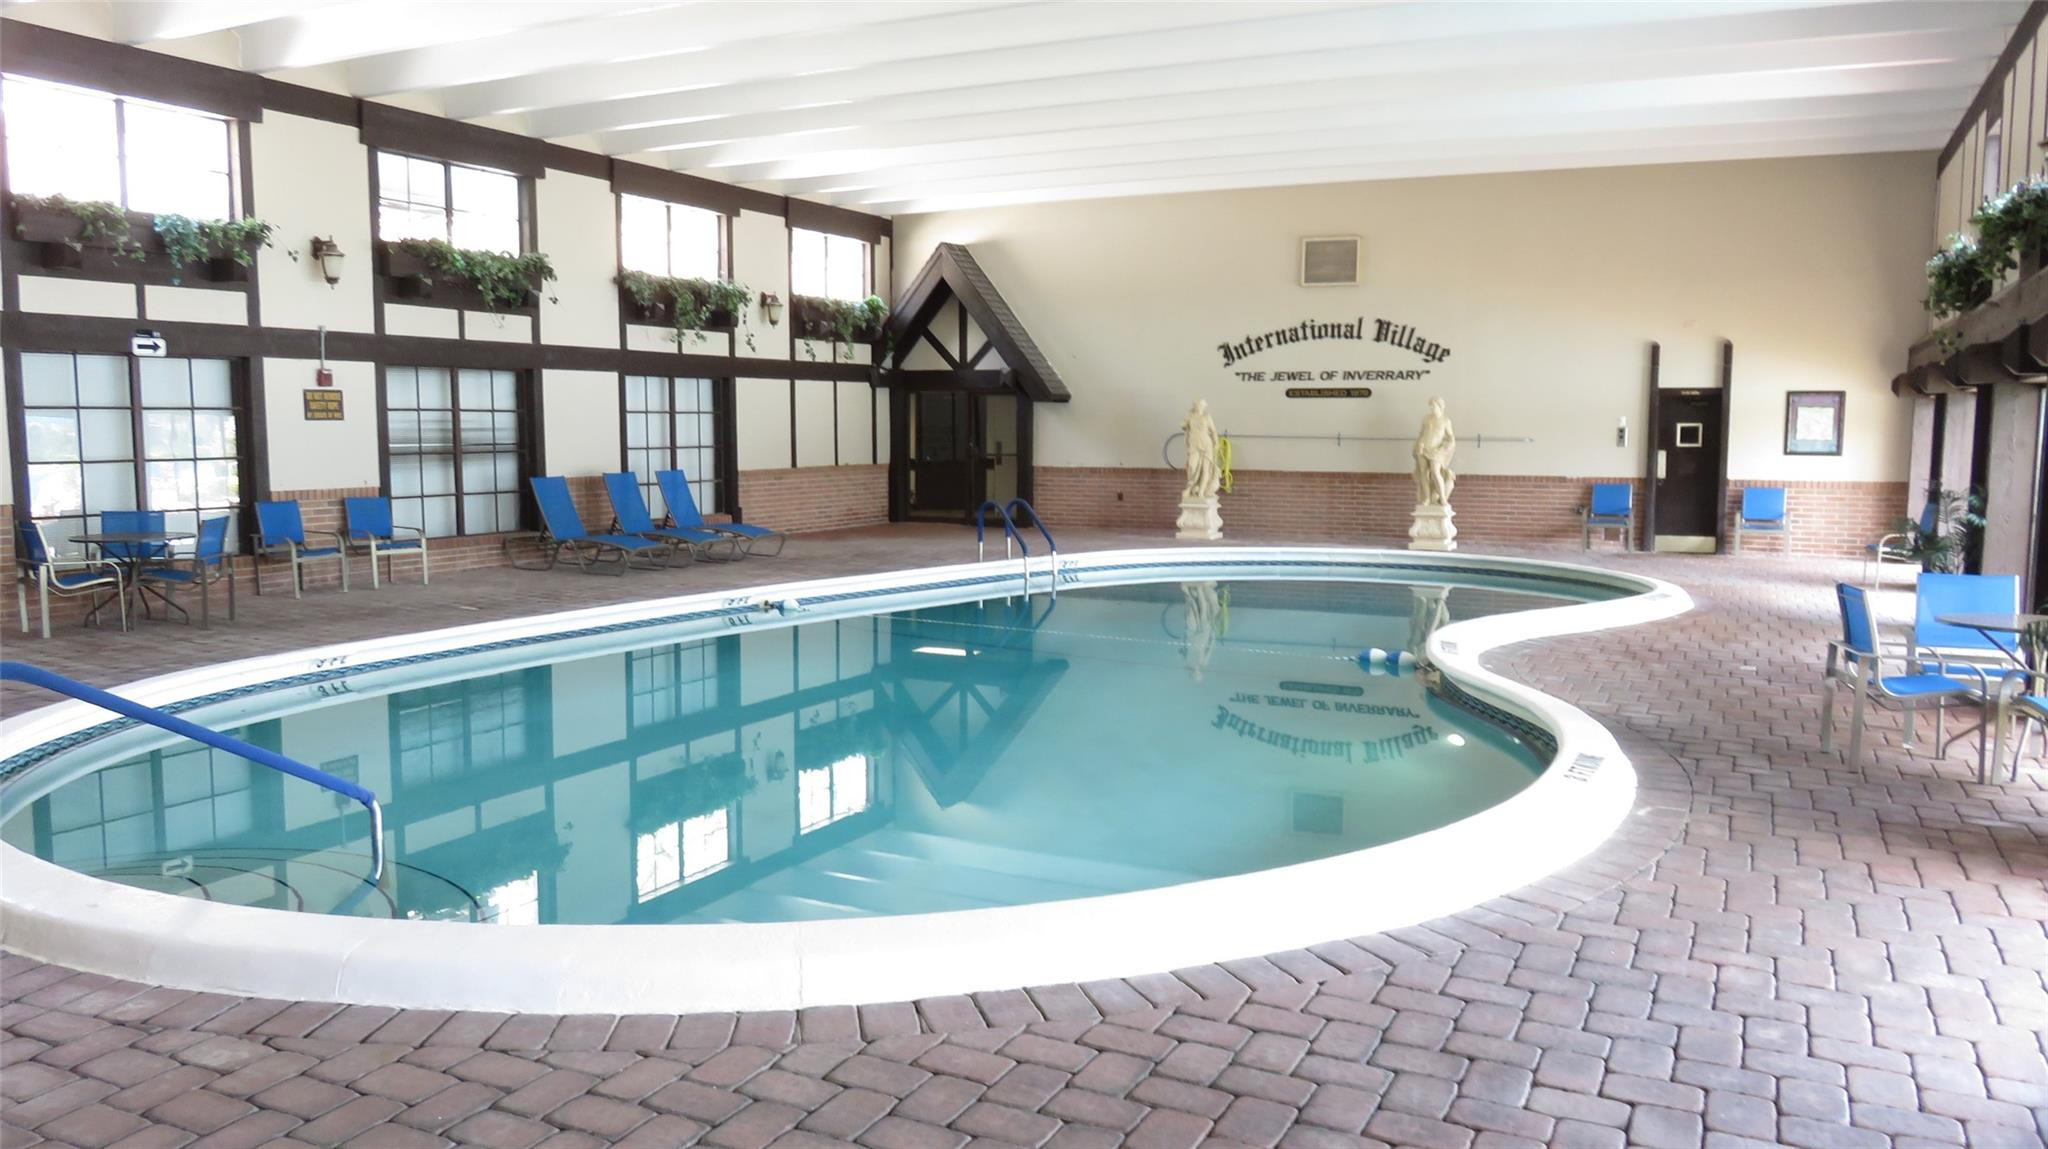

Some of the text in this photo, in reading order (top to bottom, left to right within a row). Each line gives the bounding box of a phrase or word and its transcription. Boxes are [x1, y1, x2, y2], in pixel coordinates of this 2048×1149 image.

[1218, 317, 1451, 367] International Village
[1235, 370, 1431, 382] "THE JEWEL OF INVERRARY"
